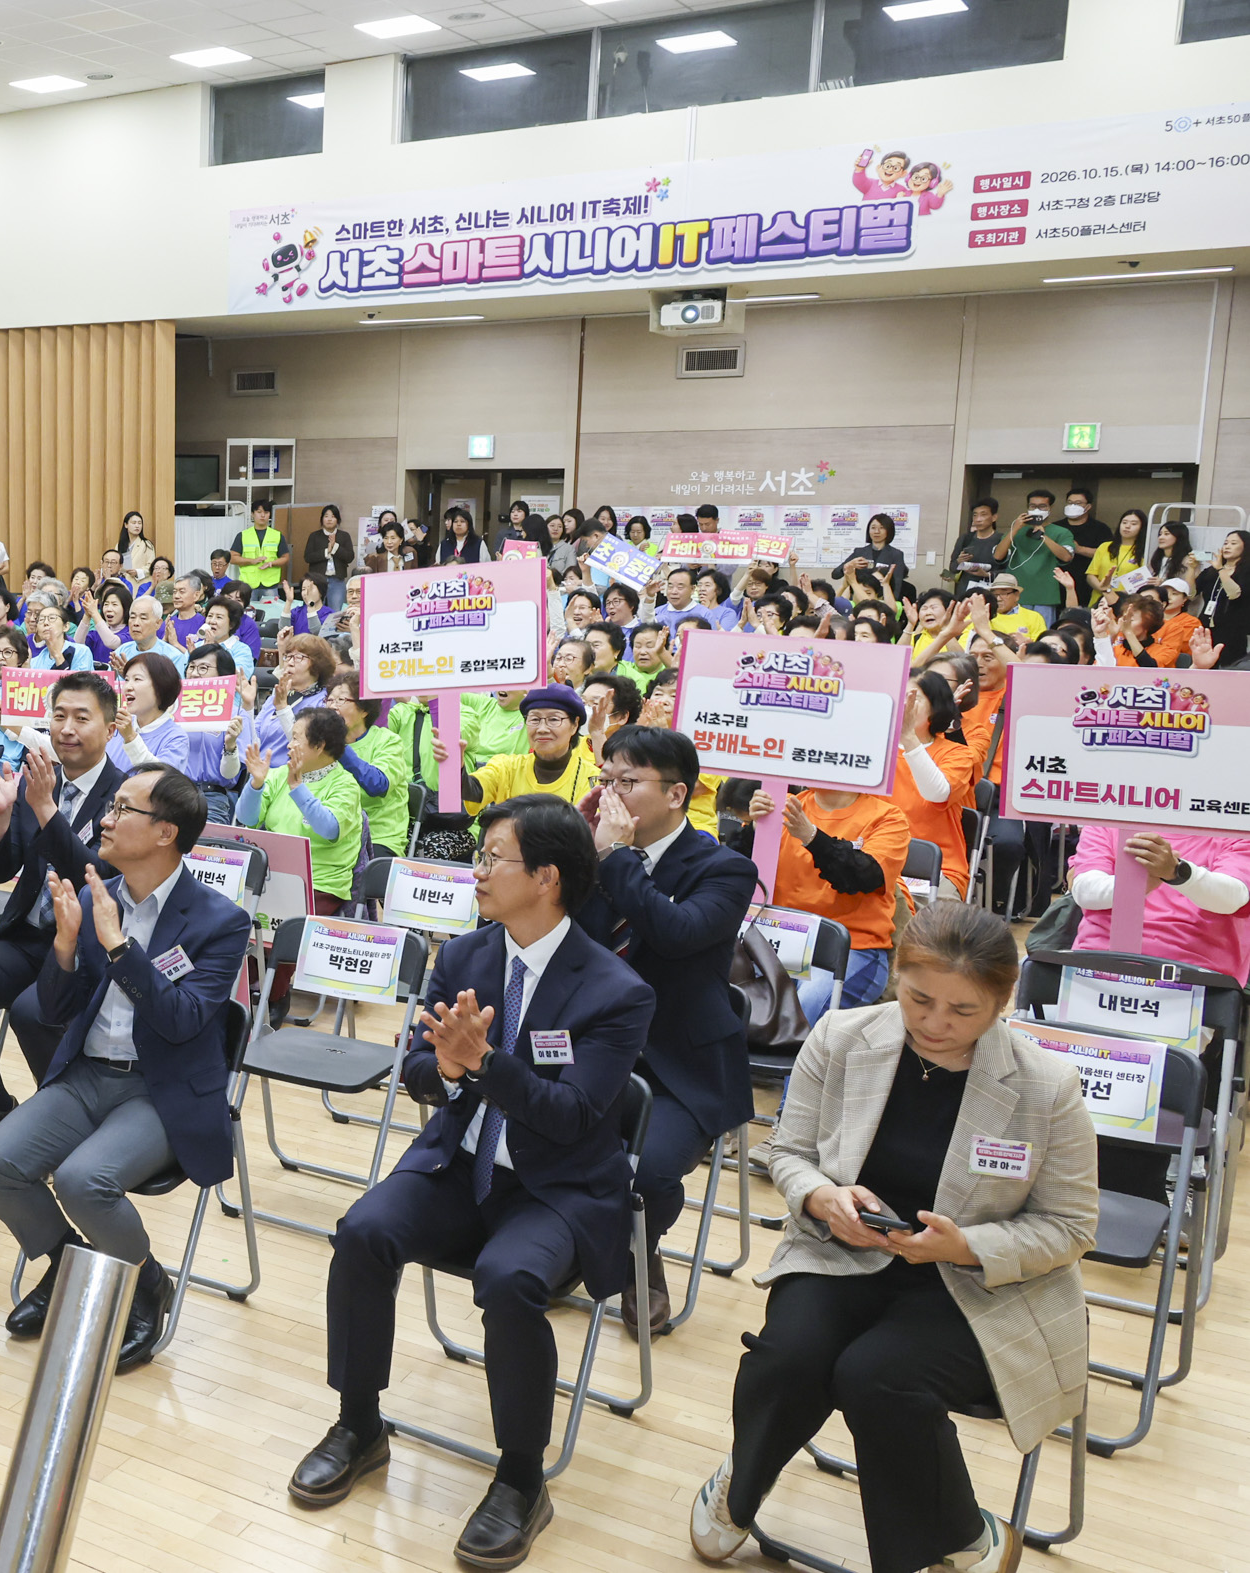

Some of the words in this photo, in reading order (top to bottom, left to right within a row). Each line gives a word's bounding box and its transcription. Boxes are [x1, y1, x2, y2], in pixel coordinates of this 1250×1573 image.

[979, 175, 1025, 190] 행사일시
[1040, 163, 1150, 185] 2026.10.15.(목)
[976, 205, 1022, 218] 행사장소
[1037, 197, 1090, 212] 서초구청
[1093, 195, 1116, 208] 2층
[1119, 191, 1161, 206] 대강당
[335, 218, 403, 242] 스마트한
[409, 215, 450, 237] 서초,
[455, 209, 510, 231] 신나는
[517, 201, 575, 225] 시니어
[581, 195, 650, 219] IT축제!
[974, 231, 1019, 245] 주최기관
[1035, 221, 1146, 240] 서초50플러스센터
[688, 470, 710, 482] 오늘
[714, 470, 756, 482] 행복하고
[758, 467, 815, 496] 서초
[670, 484, 700, 495] 내일이
[704, 484, 755, 495] 기다려지는
[428, 581, 466, 599] 서초
[406, 597, 492, 617] 스마트시니어
[412, 612, 485, 631] IT페스티벌
[379, 641, 423, 654] 서초구립
[378, 656, 454, 678] 양재노인
[460, 657, 525, 673] 종합복지관
[763, 652, 810, 675] 서초
[733, 673, 841, 696] 스마트시니어
[180, 688, 228, 717] 중앙
[740, 690, 830, 713] IT페스티벌
[1107, 686, 1167, 710] 서초
[694, 712, 749, 728] 서초구립
[1073, 708, 1206, 733] 스마트시니어
[694, 730, 785, 759] 방배노인
[792, 748, 871, 769] 종합복지관
[1082, 728, 1193, 751] IT페스티벌
[1025, 755, 1067, 774] 서초
[1020, 778, 1181, 810] 스마트시니어
[413, 887, 454, 905] 내빈석
[329, 954, 373, 974] 박현임
[1099, 993, 1160, 1017] 내빈석
[1116, 1071, 1146, 1083] 센터장
